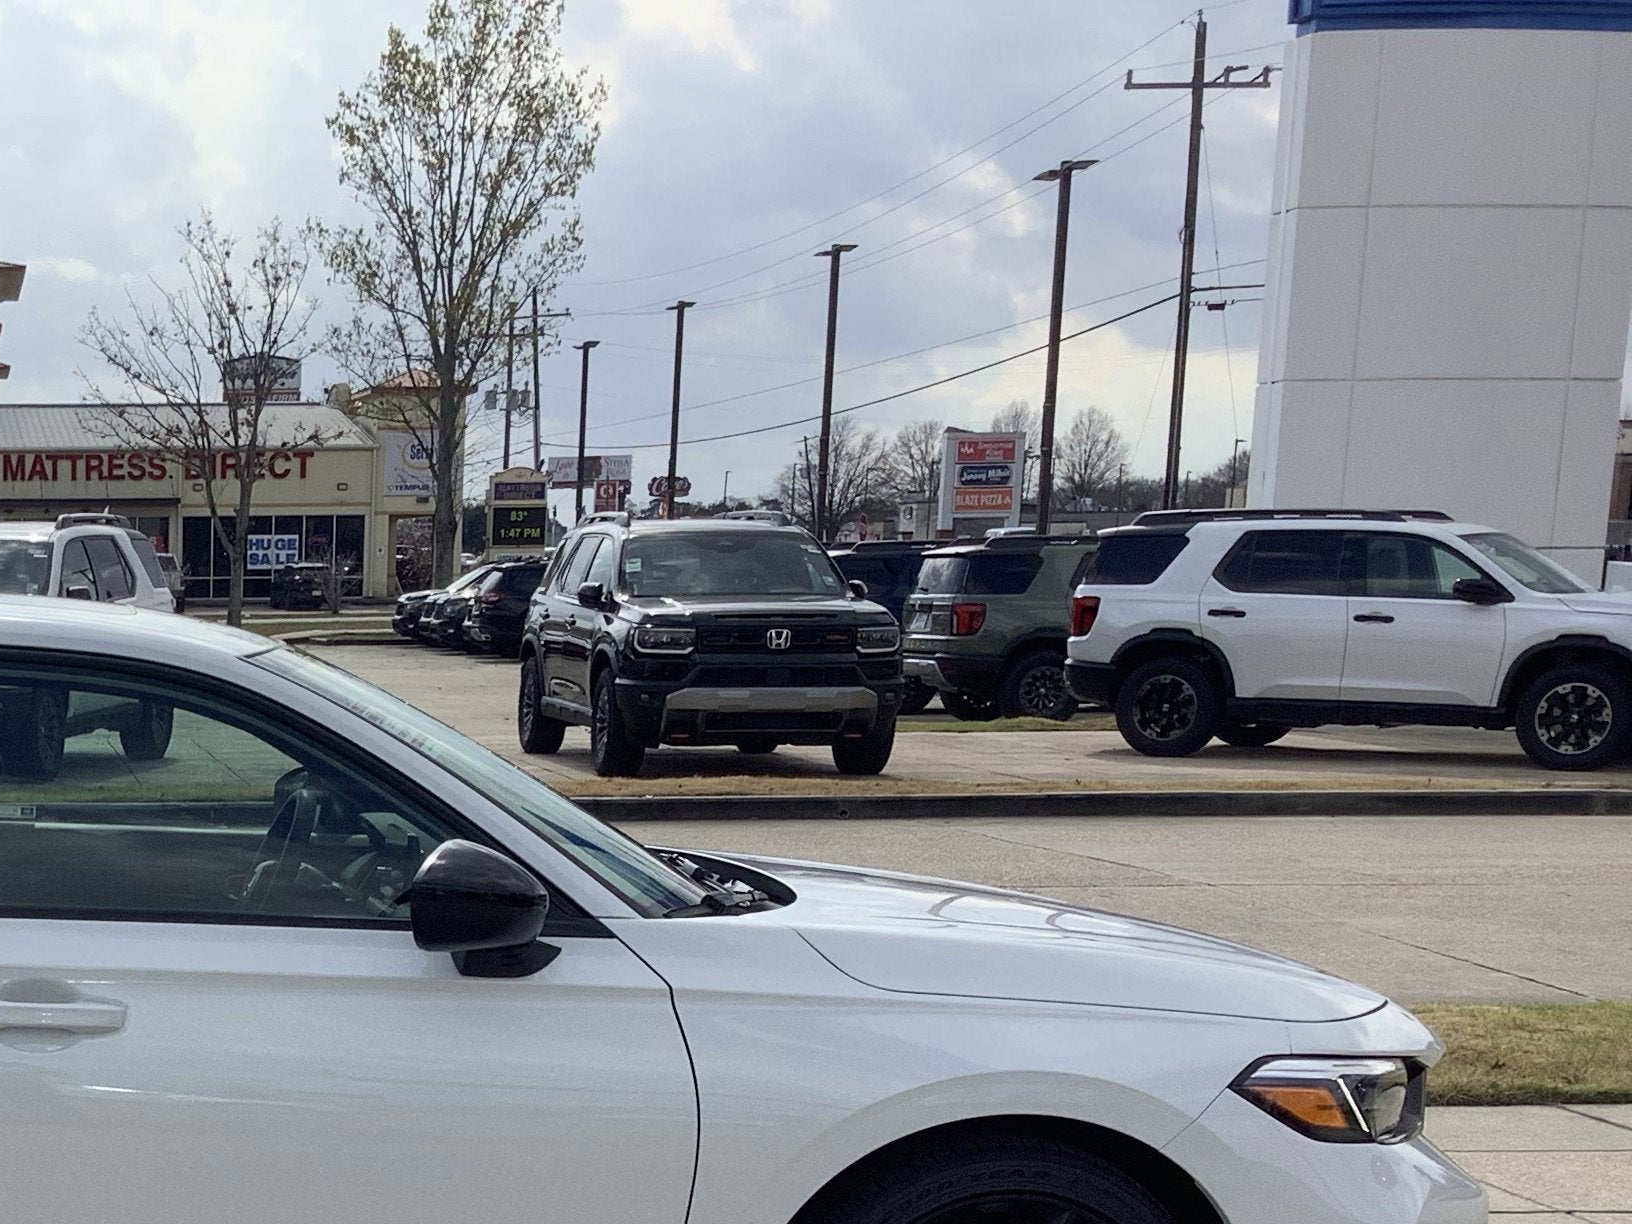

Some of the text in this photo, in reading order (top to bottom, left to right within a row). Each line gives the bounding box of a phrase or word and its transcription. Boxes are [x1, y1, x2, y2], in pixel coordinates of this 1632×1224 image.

[2, 453, 167, 481] MATTRESS
[500, 528, 541, 538] 1:47 PM
[249, 538, 297, 551] HUGE
[249, 553, 296, 566] SALE
